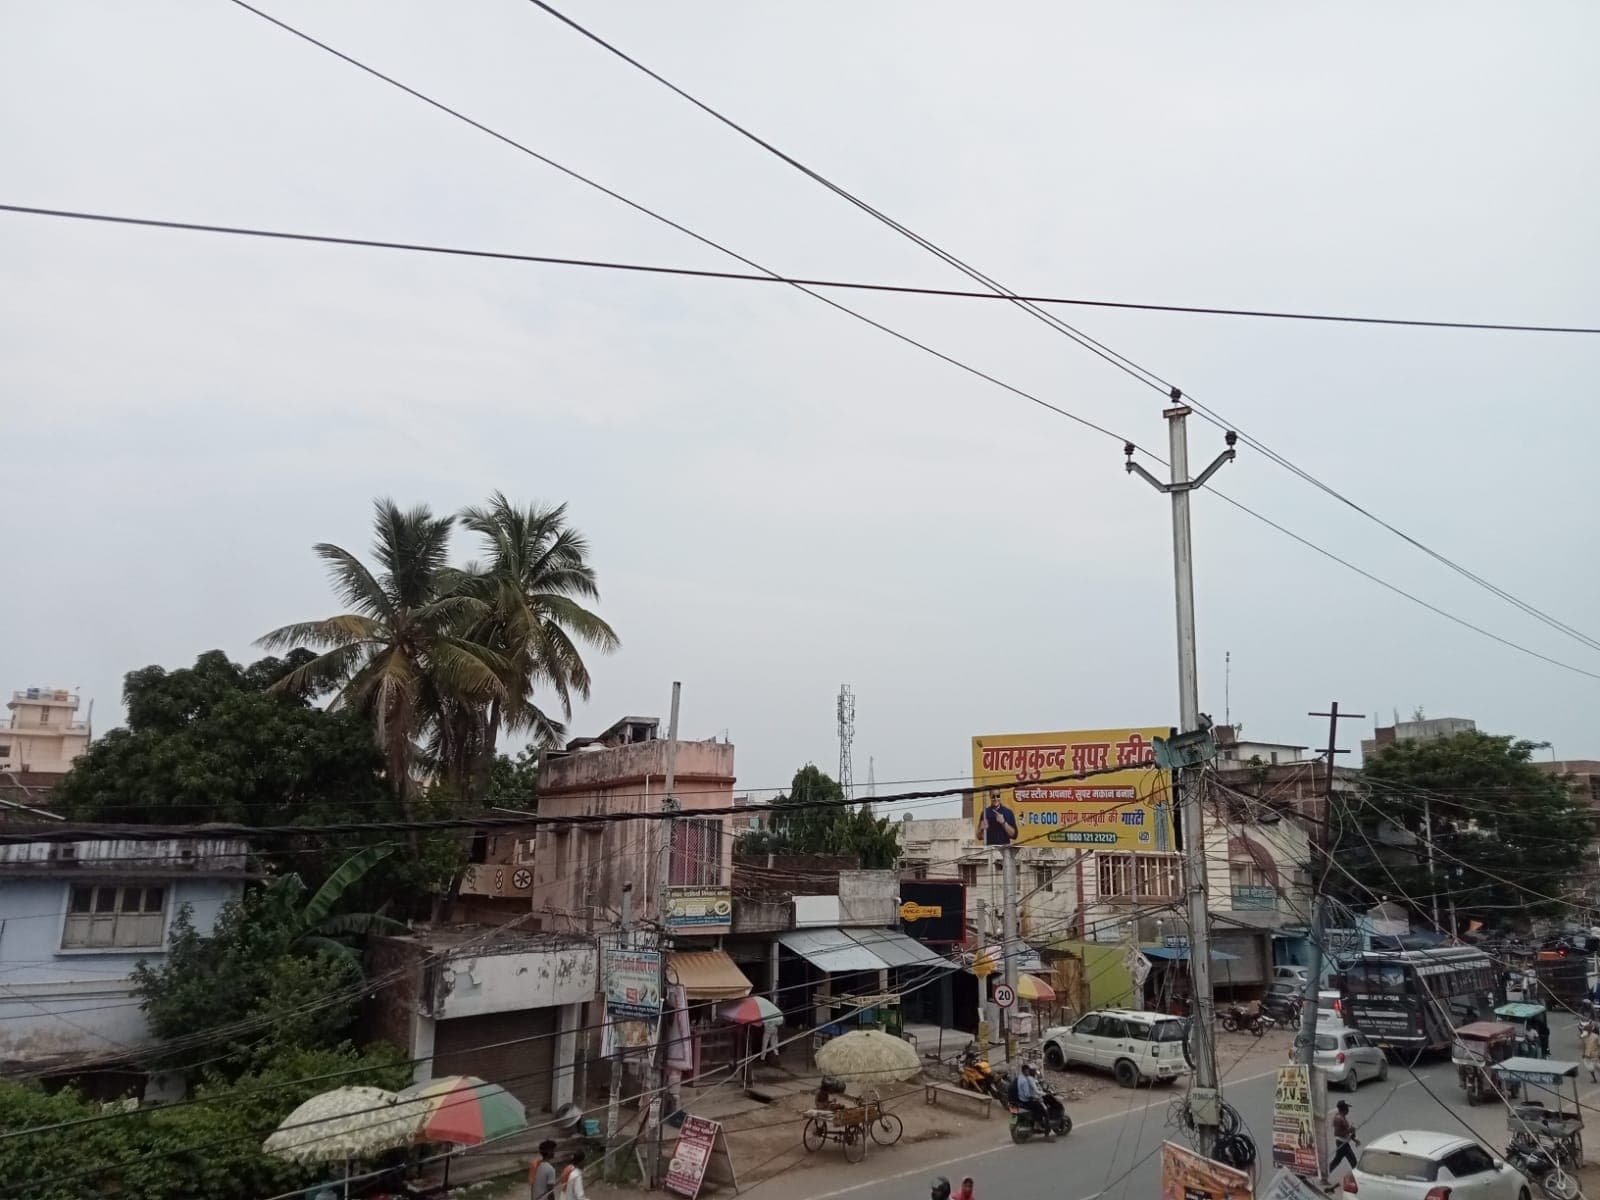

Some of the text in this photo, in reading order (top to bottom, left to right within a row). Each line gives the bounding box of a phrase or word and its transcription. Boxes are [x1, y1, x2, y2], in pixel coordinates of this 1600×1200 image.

[982, 744, 1067, 780] बालमुकुन्द
[1071, 743, 1110, 780] सुपर
[1028, 812, 1039, 824] Fe
[1040, 811, 1058, 824] 600
[1083, 833, 1094, 841] 121
[998, 990, 1011, 1001] 20
